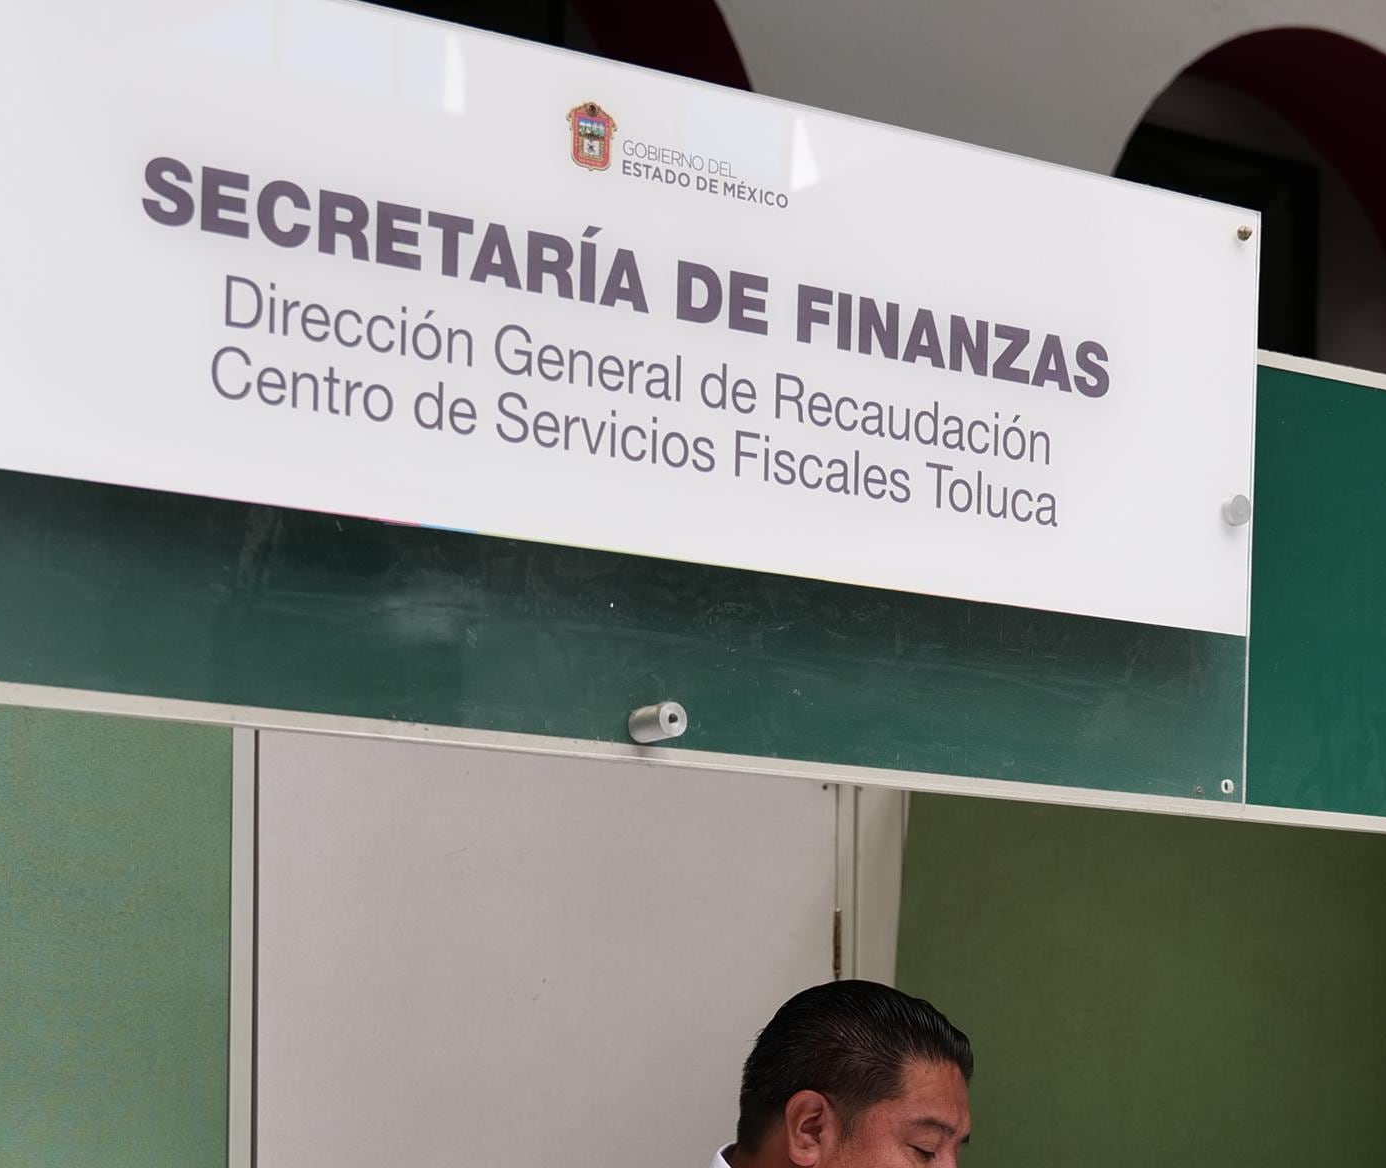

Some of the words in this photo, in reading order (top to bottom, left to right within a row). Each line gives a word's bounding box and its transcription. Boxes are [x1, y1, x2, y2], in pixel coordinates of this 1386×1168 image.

[621, 159, 691, 188] ESTADO
[695, 175, 719, 195] DE
[722, 180, 789, 209] MÉXICO
[622, 139, 704, 171] GOBIERNO
[707, 158, 738, 180] DEL
[140, 156, 650, 315] SECRETARÍA
[675, 259, 770, 337] DE
[796, 283, 1111, 405] FINANZAS
[224, 274, 474, 368] Dirección
[494, 323, 682, 403] General
[700, 362, 758, 415] de
[774, 372, 1051, 466] Recaudación
[210, 345, 394, 423] Centro
[413, 380, 478, 436] de
[495, 391, 716, 473] Servicios
[734, 429, 912, 504] Fiscales
[925, 461, 1059, 528] Toluca
